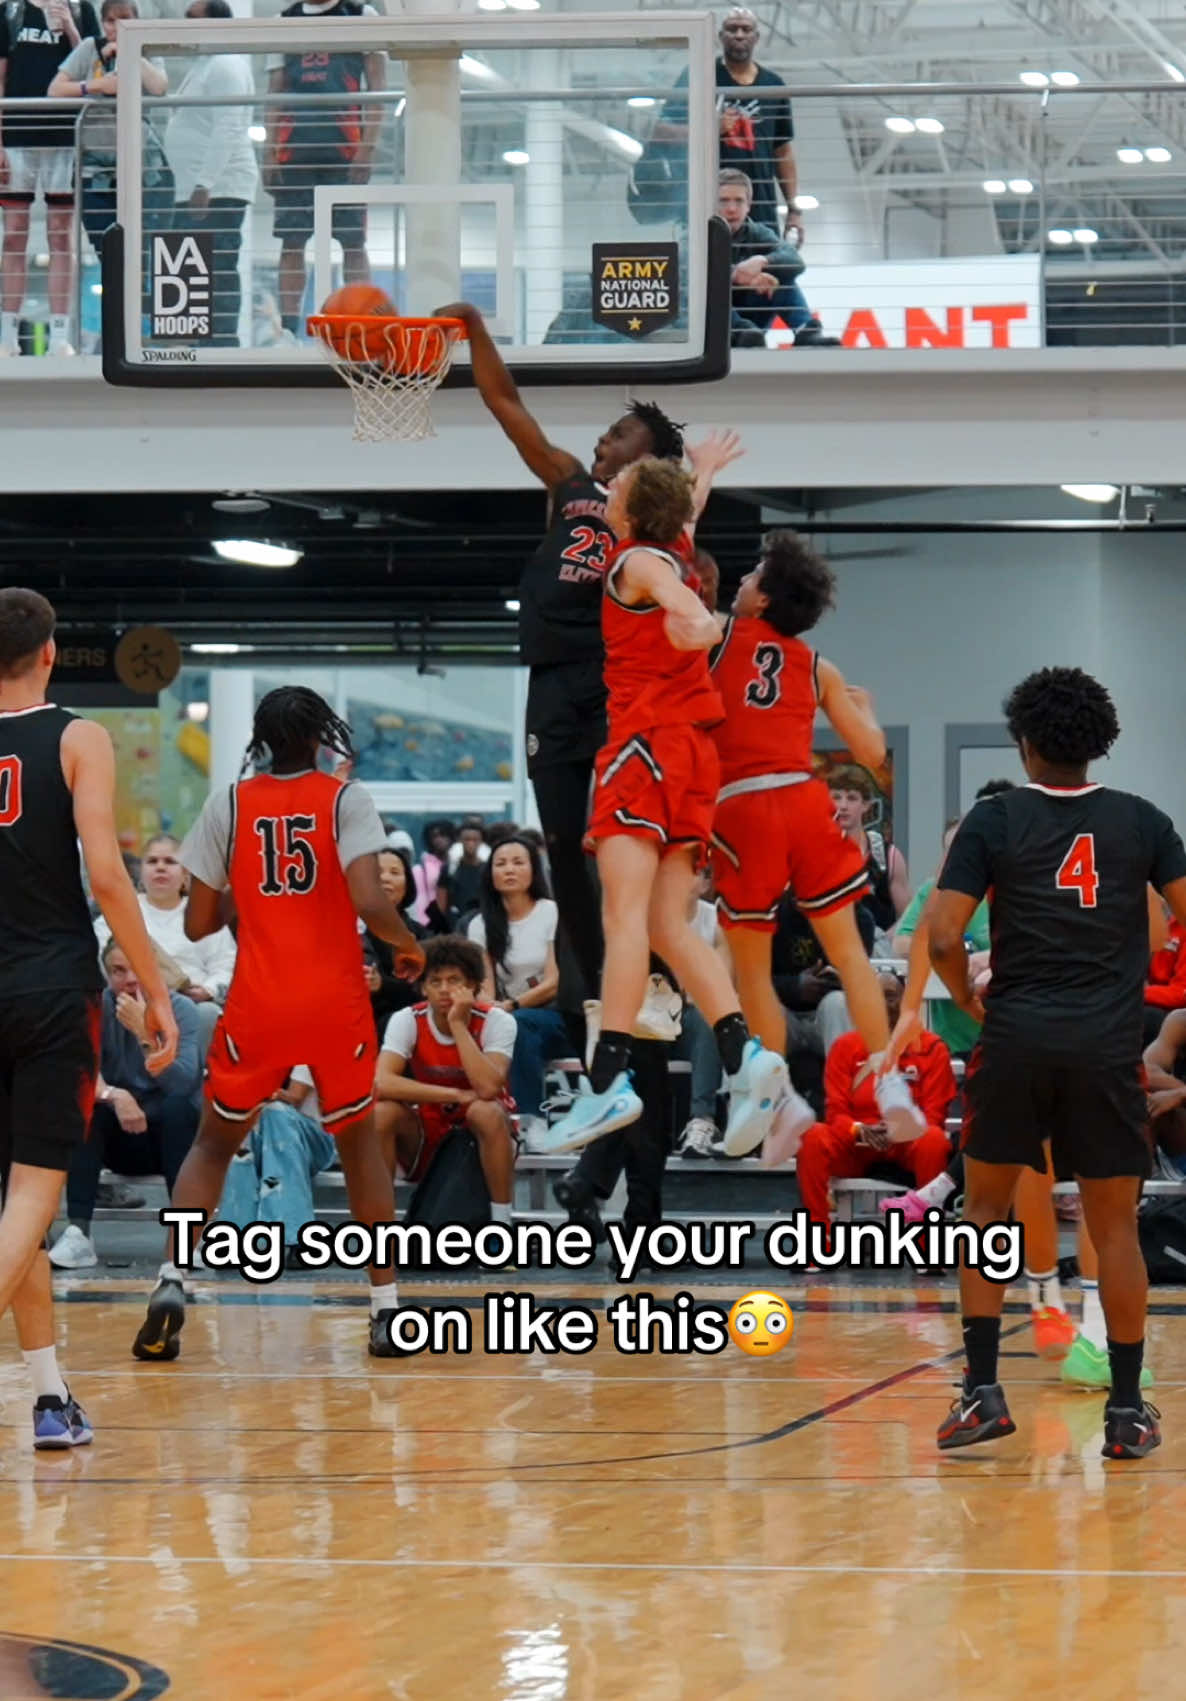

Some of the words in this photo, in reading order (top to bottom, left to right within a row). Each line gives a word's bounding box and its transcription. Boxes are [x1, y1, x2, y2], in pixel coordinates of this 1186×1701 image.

[601, 279, 669, 291] NATIONAL
[602, 261, 668, 278] ARMY
[600, 291, 670, 309] GUARD
[153, 316, 209, 335] HOOPS
[771, 302, 1028, 348] ANT
[142, 350, 198, 362] SPALDING
[560, 526, 613, 572] 23
[744, 641, 785, 710] 3
[253, 814, 319, 896] 15
[1055, 833, 1099, 908] 4
